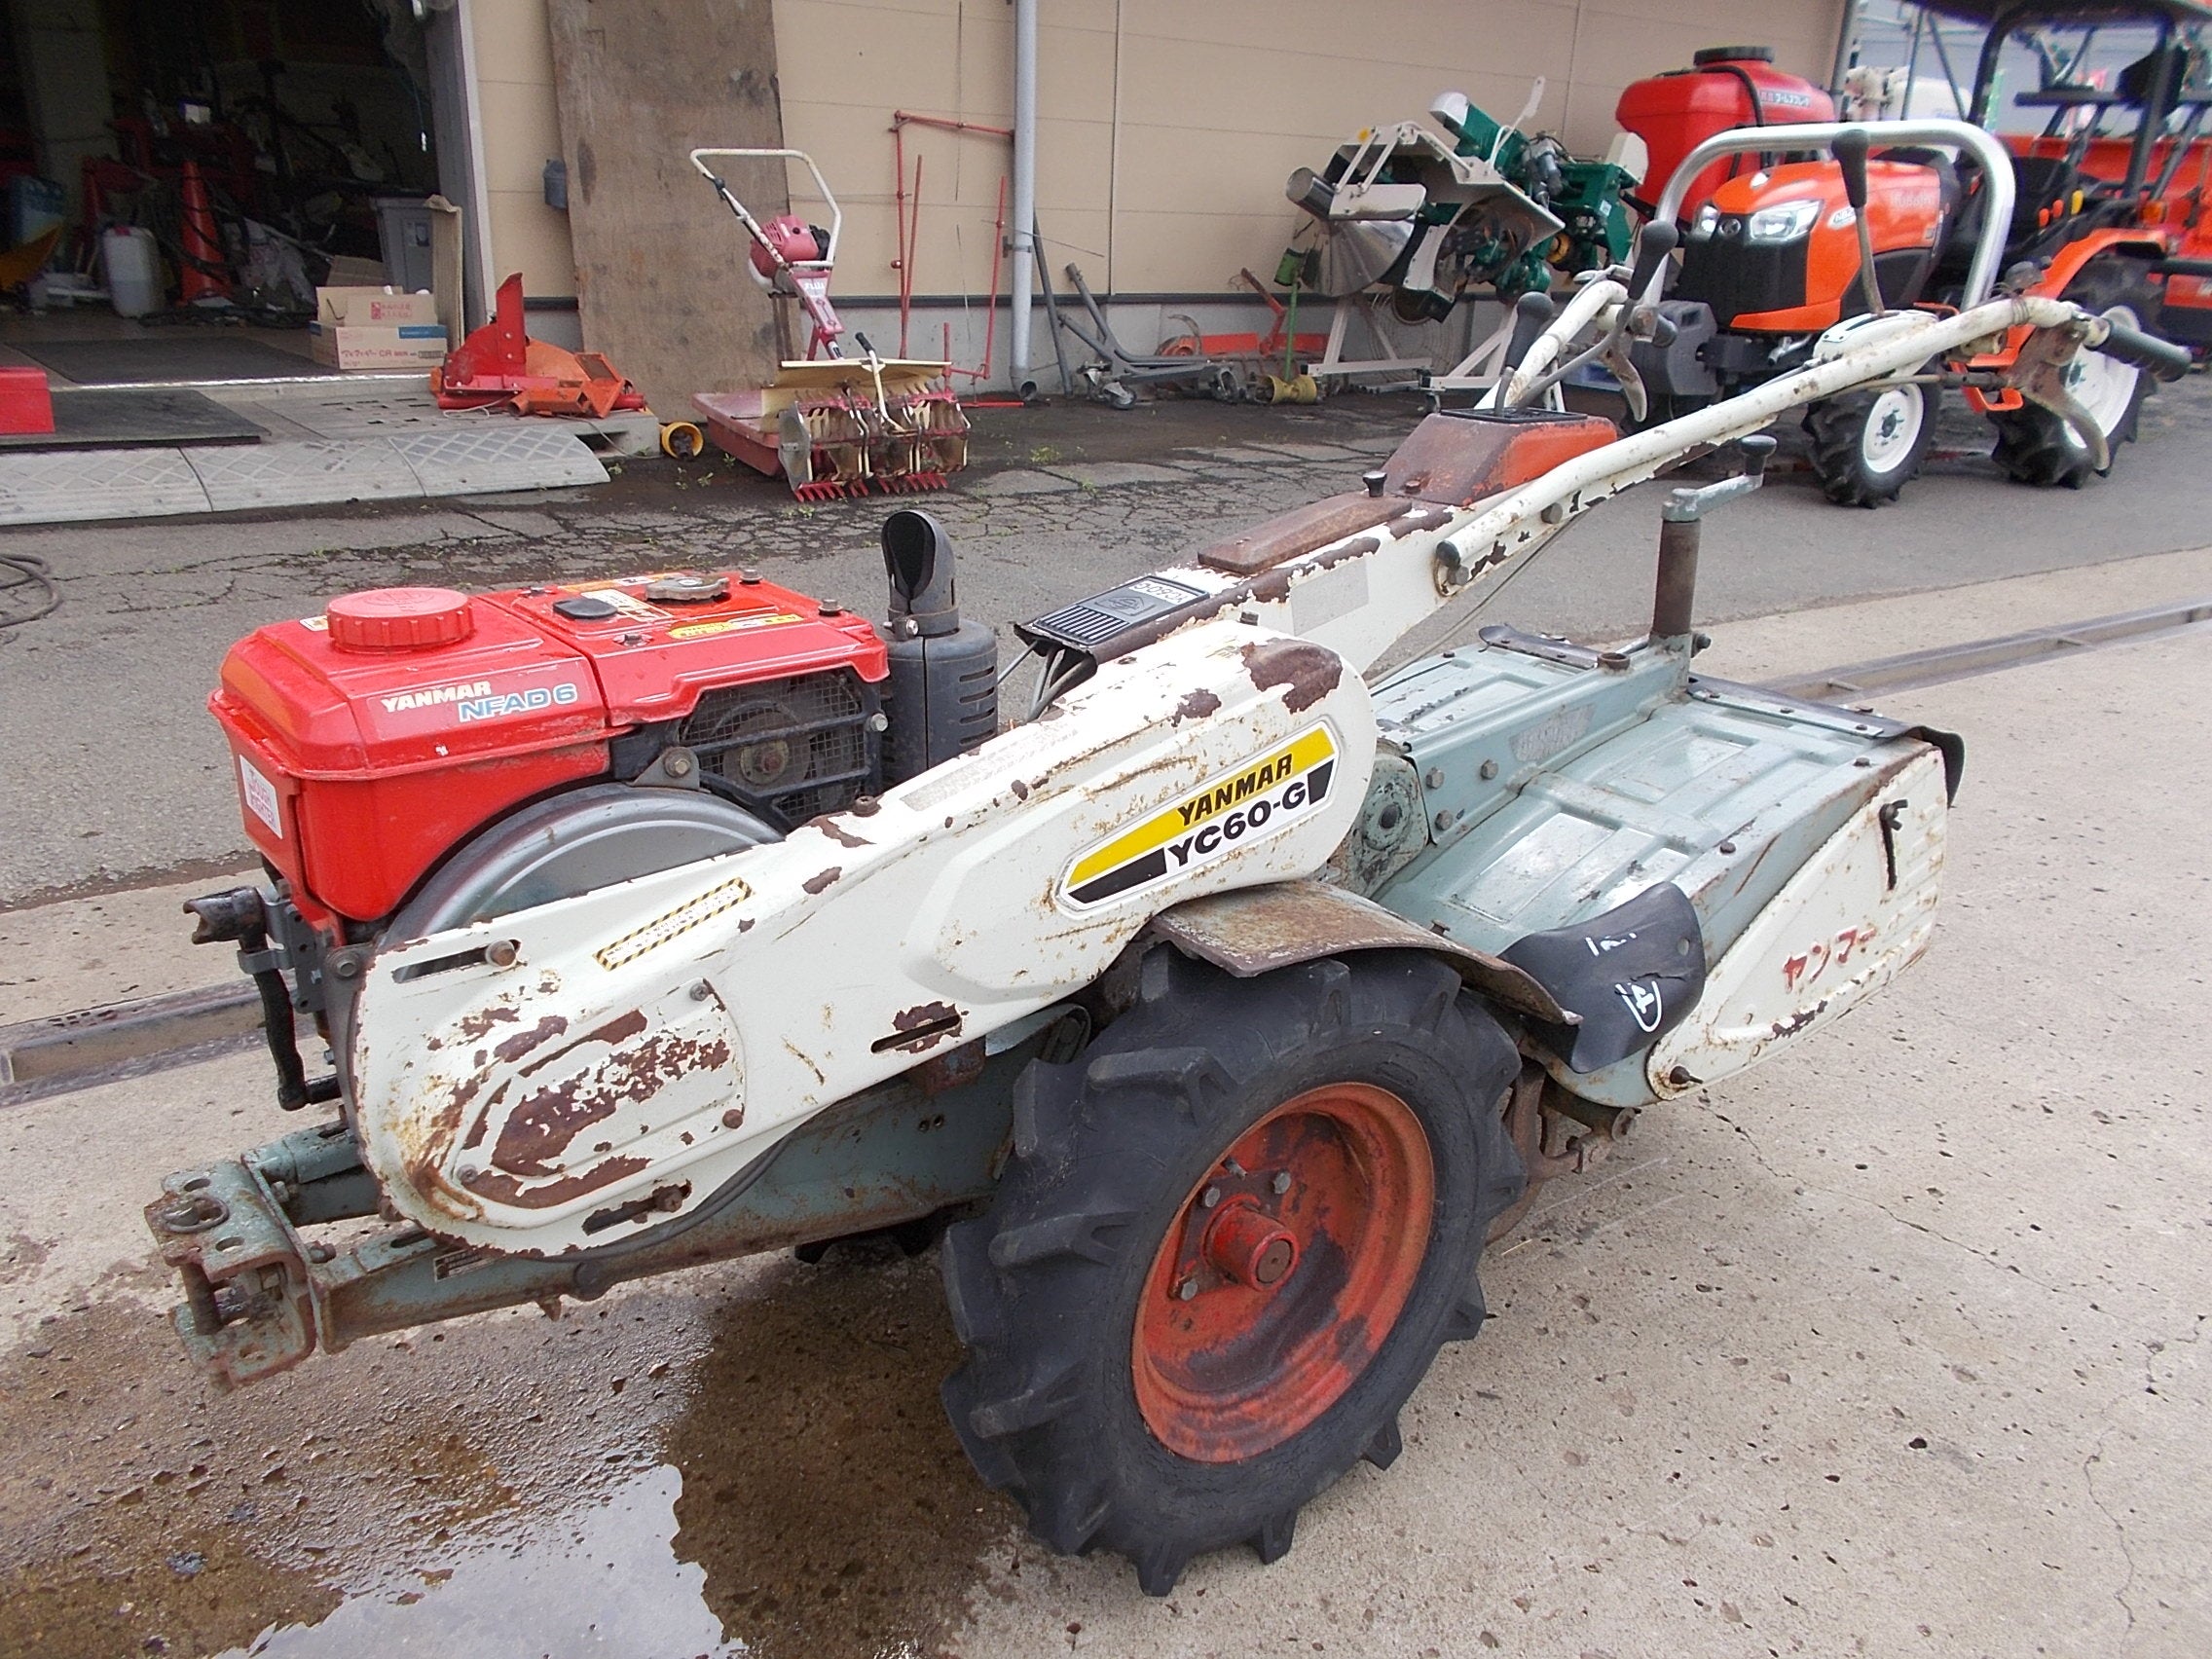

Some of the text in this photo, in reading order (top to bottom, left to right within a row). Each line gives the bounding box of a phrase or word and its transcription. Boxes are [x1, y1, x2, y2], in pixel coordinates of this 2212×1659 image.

[381, 681, 492, 713] YANMAR
[1168, 781, 1307, 867] YC60-G
[1177, 753, 1293, 827] YANMAR
[1783, 926, 1877, 991] ヤンマー
